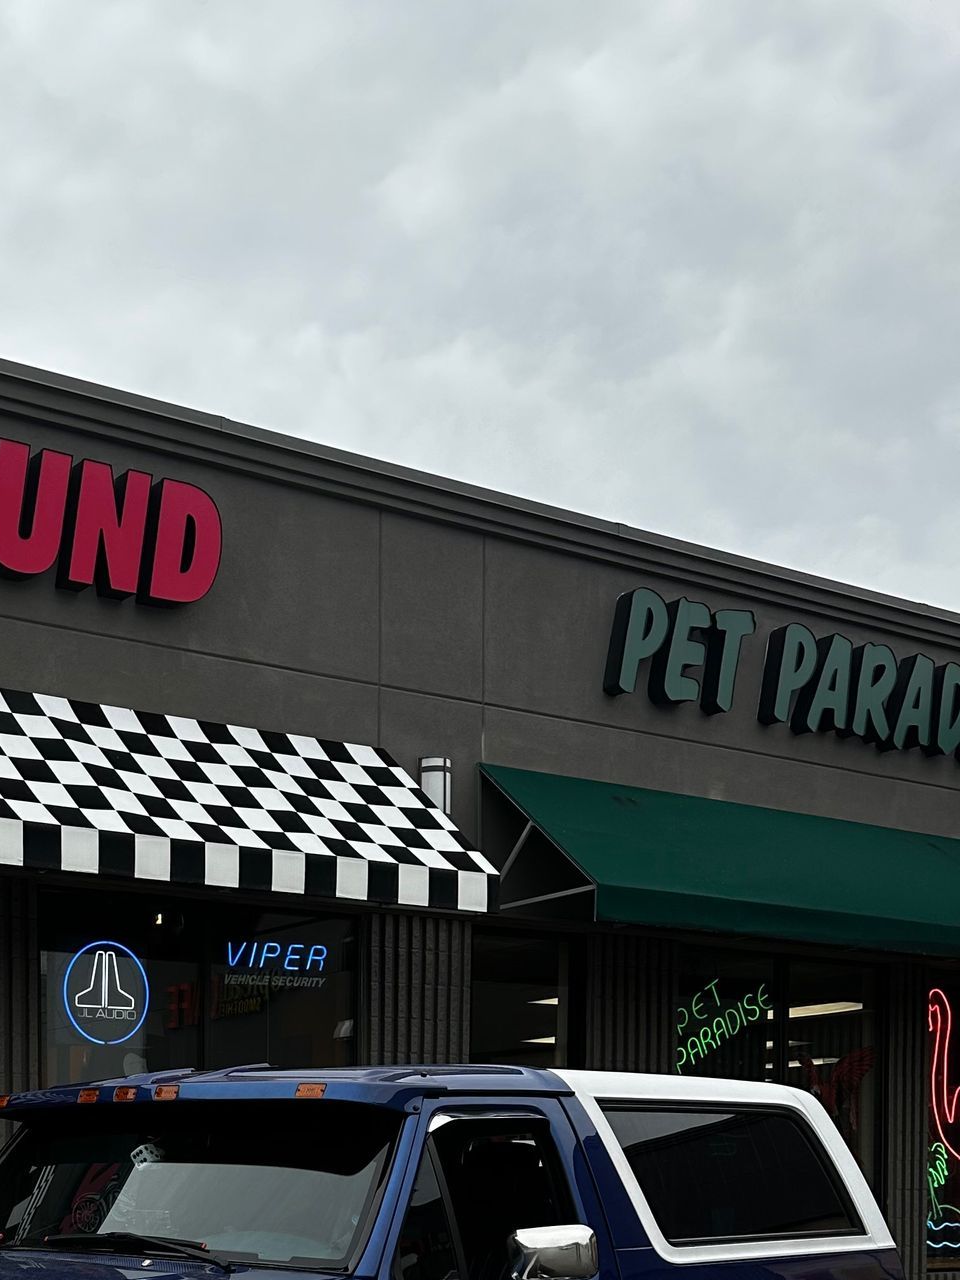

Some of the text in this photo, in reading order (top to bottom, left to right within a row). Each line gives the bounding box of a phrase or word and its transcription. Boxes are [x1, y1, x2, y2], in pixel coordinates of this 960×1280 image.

[605, 587, 756, 715] PET
[226, 940, 329, 972] VIPER
[223, 973, 270, 986] VEHICLE
[271, 974, 327, 988] SECURITY
[77, 1008, 137, 1021] JL AUDIO
[676, 978, 721, 1037] PET
[676, 983, 774, 1076] PARADISE
